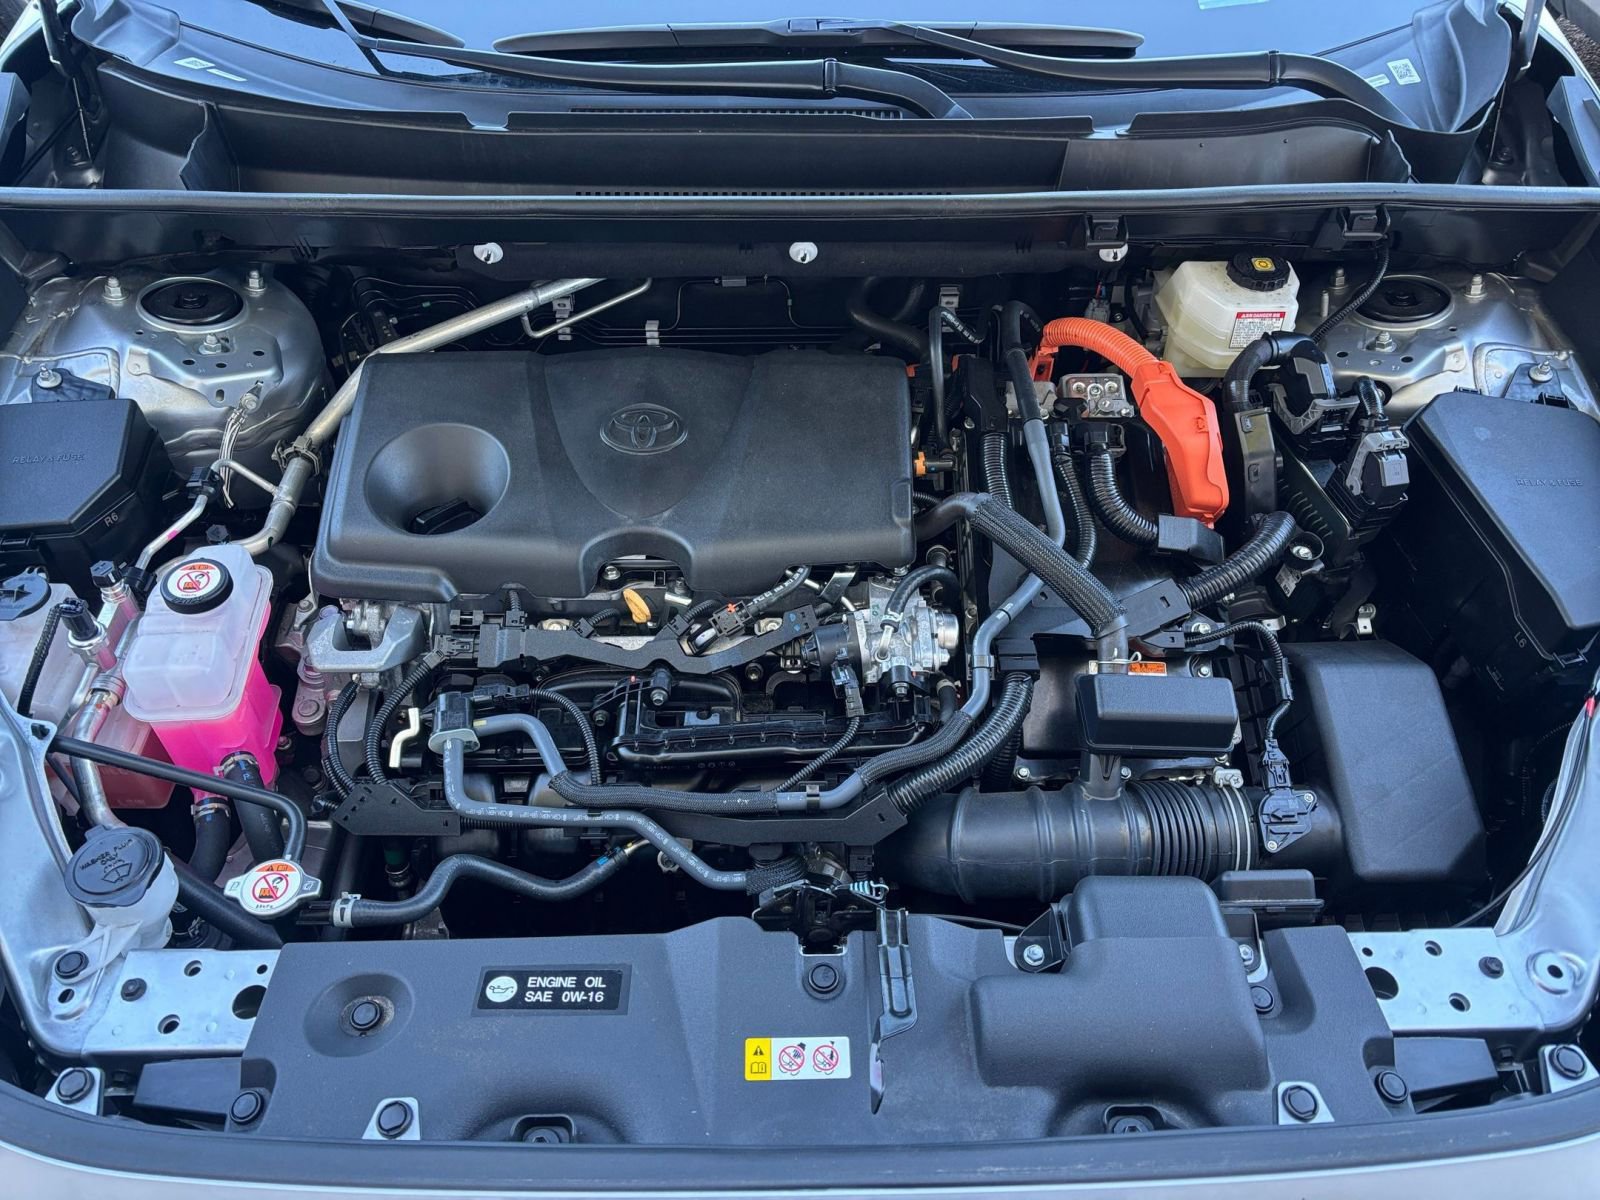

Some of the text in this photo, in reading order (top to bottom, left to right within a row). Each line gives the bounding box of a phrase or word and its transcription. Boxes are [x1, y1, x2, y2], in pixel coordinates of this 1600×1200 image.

[12, 455, 46, 464] RELAY
[57, 453, 85, 463] FUSE
[1515, 479, 1546, 487] RELAY
[1557, 479, 1584, 487] FUSE
[104, 512, 119, 527] R6
[1514, 631, 1527, 648] L6
[527, 976, 607, 988] ENGINE OIL
[524, 991, 604, 1003] SAE 0W-16
